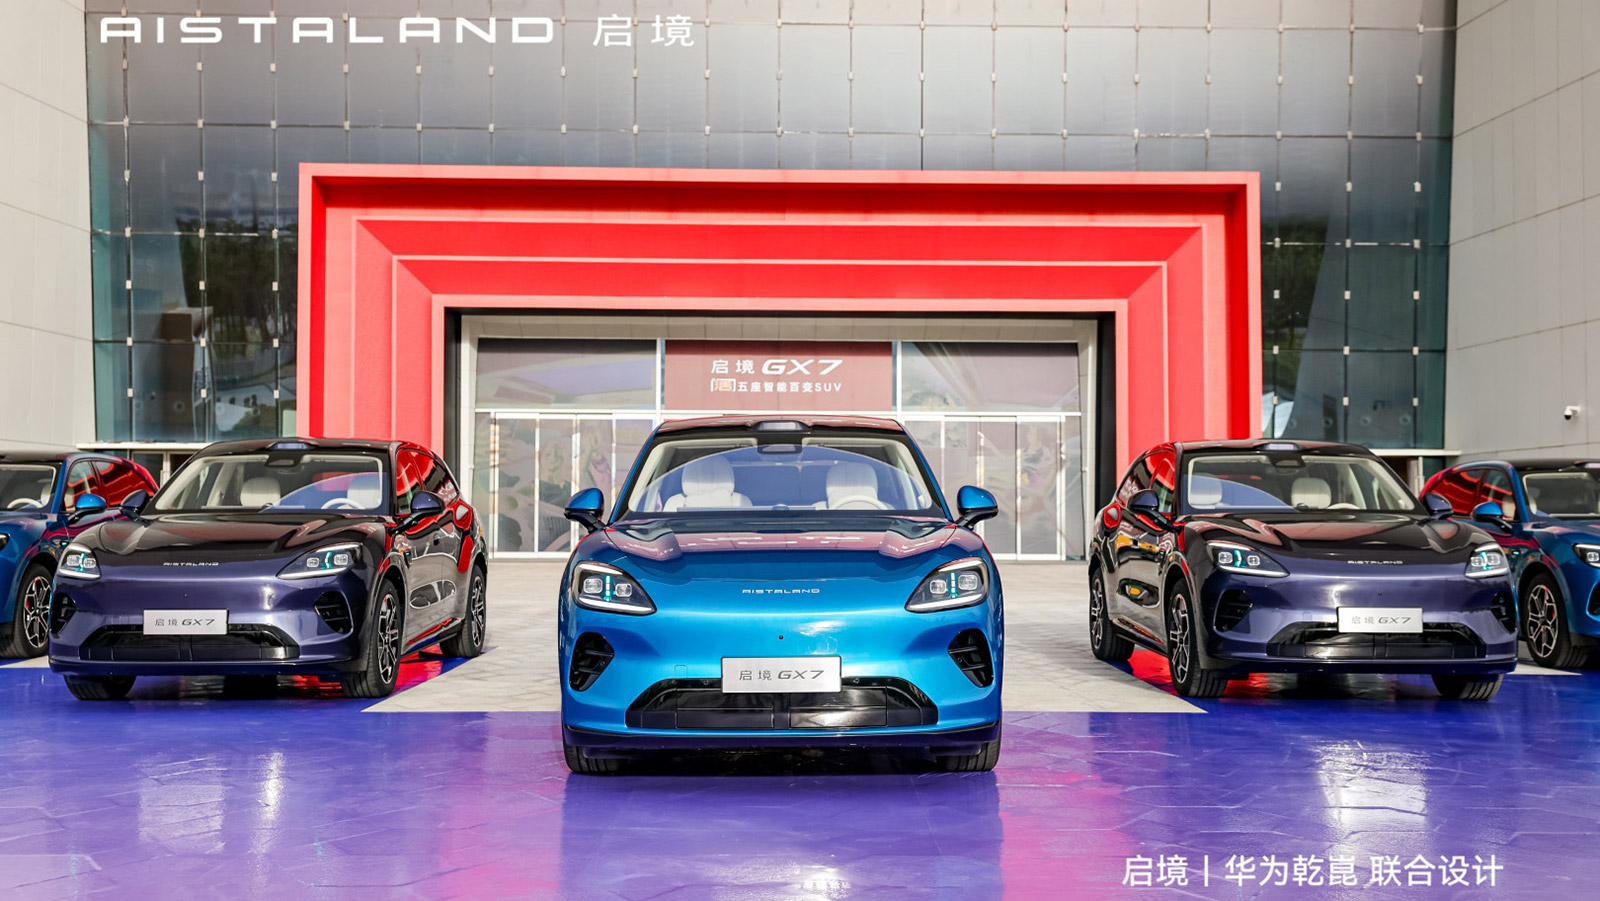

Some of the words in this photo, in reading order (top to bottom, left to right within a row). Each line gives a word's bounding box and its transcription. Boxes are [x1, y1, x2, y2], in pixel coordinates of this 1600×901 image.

[711, 359, 755, 374] 启境
[761, 359, 843, 375] GX7
[739, 669, 772, 681] 启境
[777, 670, 825, 680] GX7
